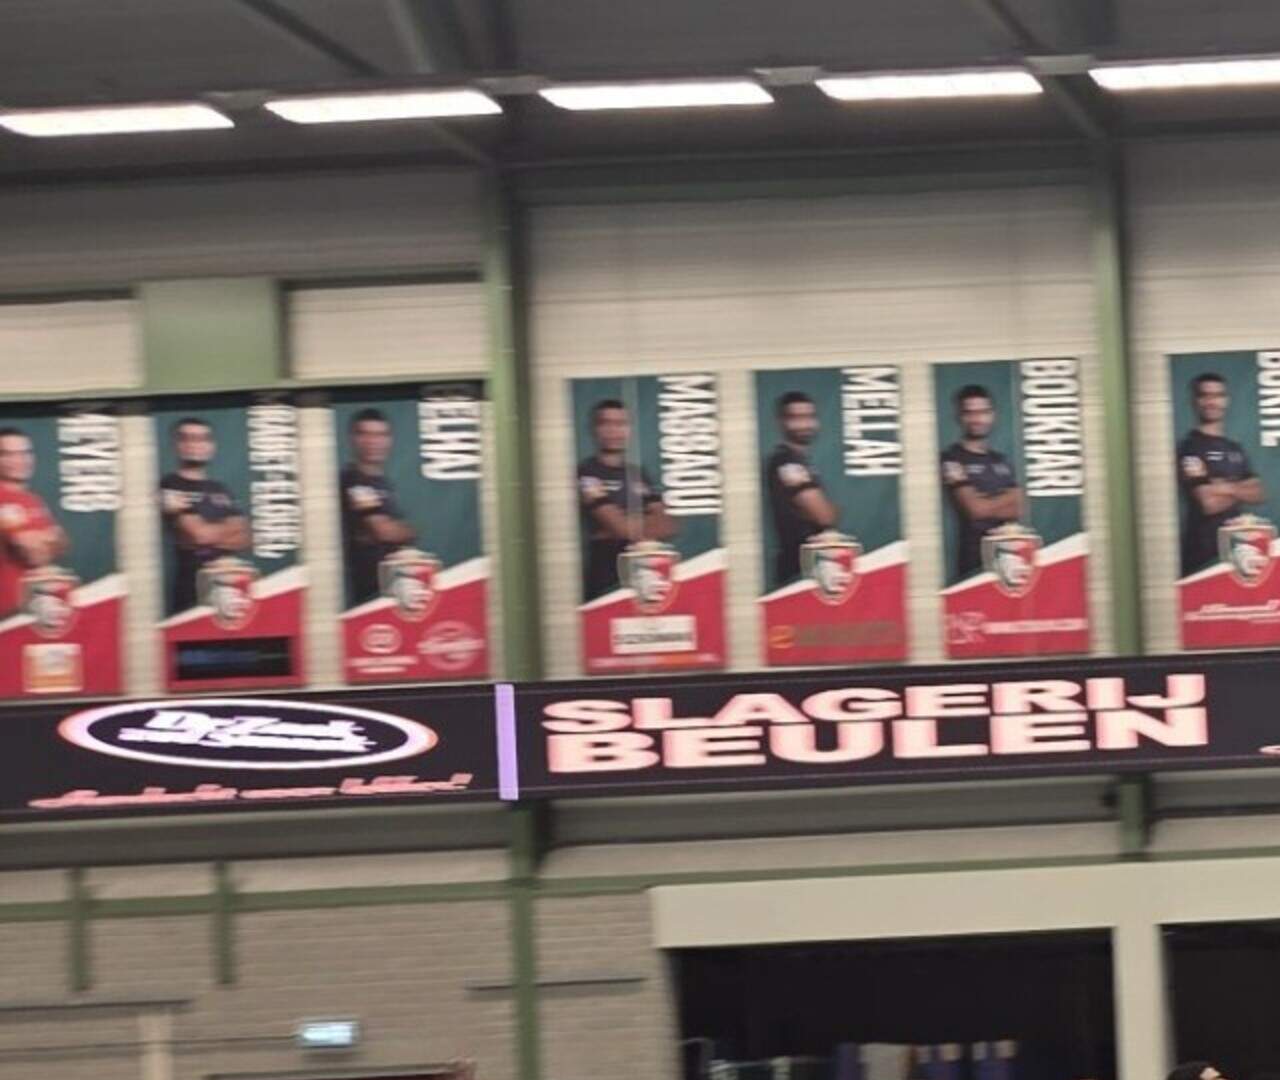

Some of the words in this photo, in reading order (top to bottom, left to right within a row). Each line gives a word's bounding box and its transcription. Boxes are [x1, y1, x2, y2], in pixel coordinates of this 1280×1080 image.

[417, 396, 484, 481] ELHAJ
[841, 366, 901, 477] MELLAH
[1020, 358, 1084, 497] BOUKHARI
[541, 673, 1207, 735] SLAGERIJ
[546, 709, 1209, 773] BEULEN
